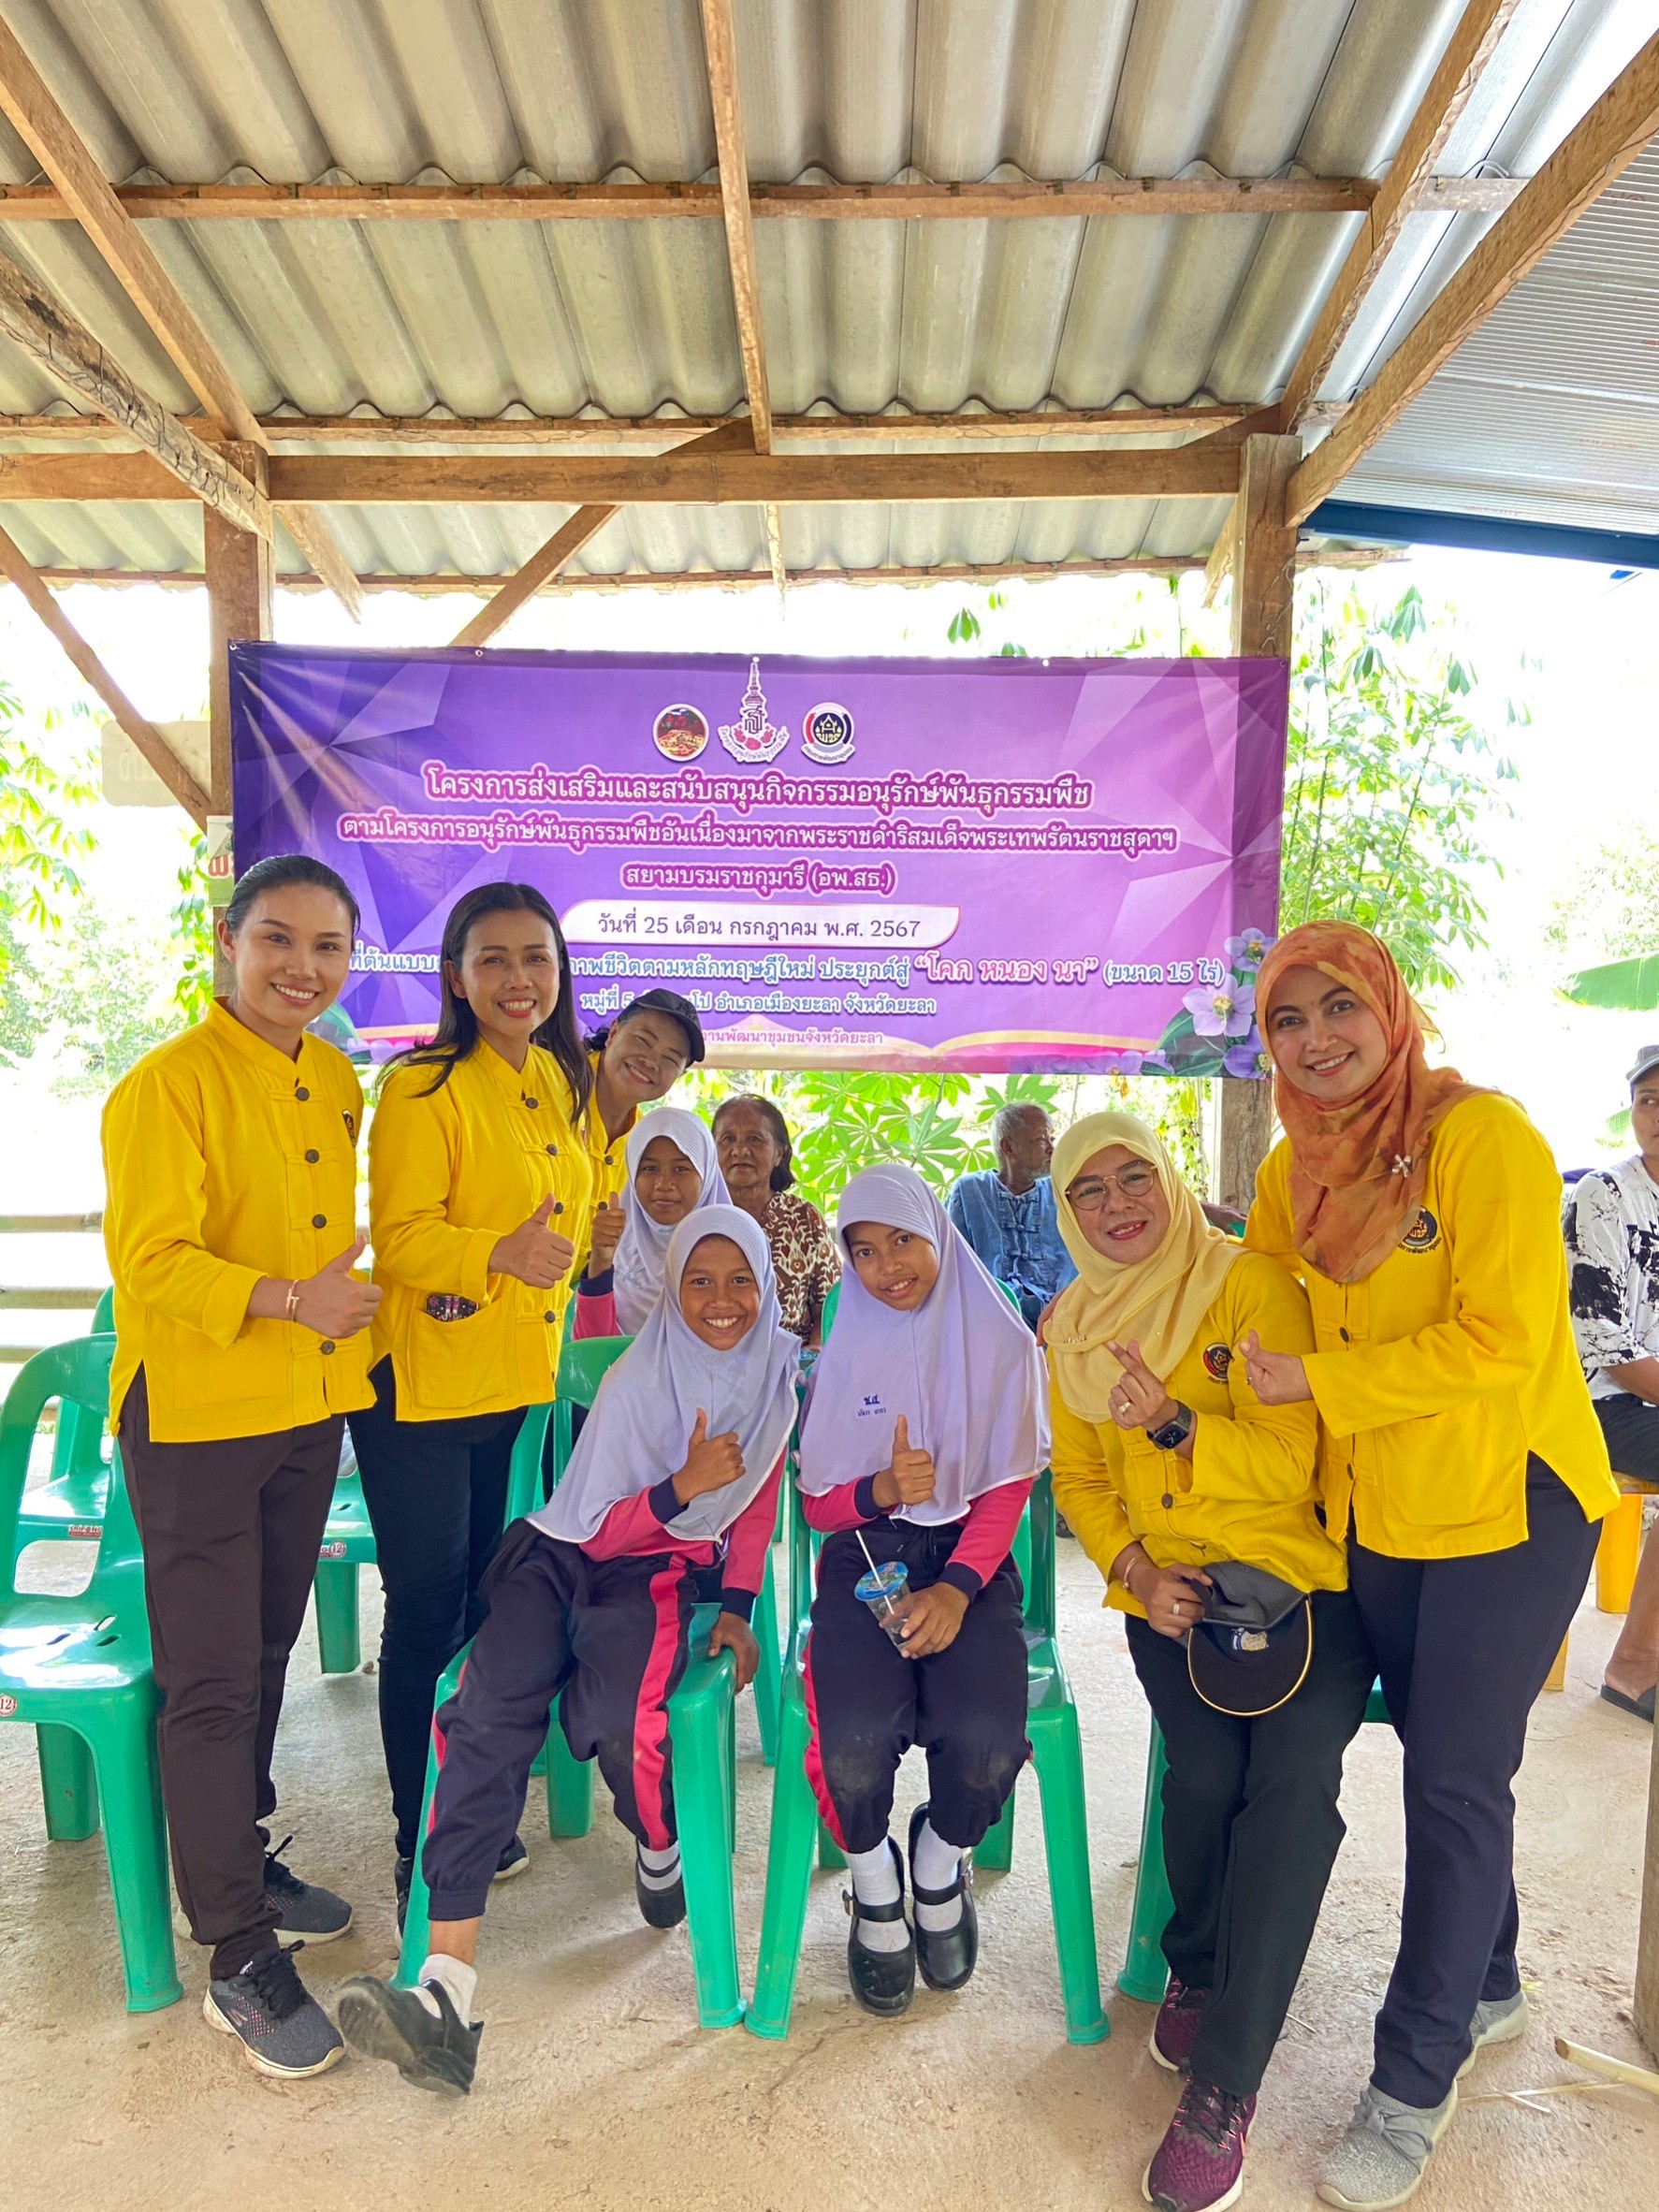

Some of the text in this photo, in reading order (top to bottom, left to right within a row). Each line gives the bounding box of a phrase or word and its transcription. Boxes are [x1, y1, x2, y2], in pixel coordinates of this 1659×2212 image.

[428, 766, 1089, 813] โครงการส่งเสริมและสนับสนุนกิจกรรมอนุรักษ์พันธุกรรมพืช
[343, 814, 1176, 854] ตามโครงการอนุรักษ์พันธุกรรมพืชอันเนื่องมาจากพระราชดำริสมเด็จพระเทพรัตนราชสุดาฯ
[626, 863, 893, 894] สยามบรมราชกุมารี (อพ.สธ.)
[598, 907, 921, 941] วันที่ 25 เดือน กรกฎาคม พ.ศ. 2567
[351, 943, 440, 970] ที่ต้นแบบ
[820, 956, 910, 987] ประยุกต์สู่
[982, 960, 1045, 982] หนอง
[1104, 961, 1161, 986] (ขนาด
[1169, 964, 1192, 982] 15
[1200, 959, 1225, 986] ไร่)
[581, 986, 618, 1013] หมู่ที่
[622, 993, 633, 1007] 5
[717, 994, 841, 1013] อำเภอเมืองยะลา
[846, 995, 937, 1014] จังหวัดยะลา
